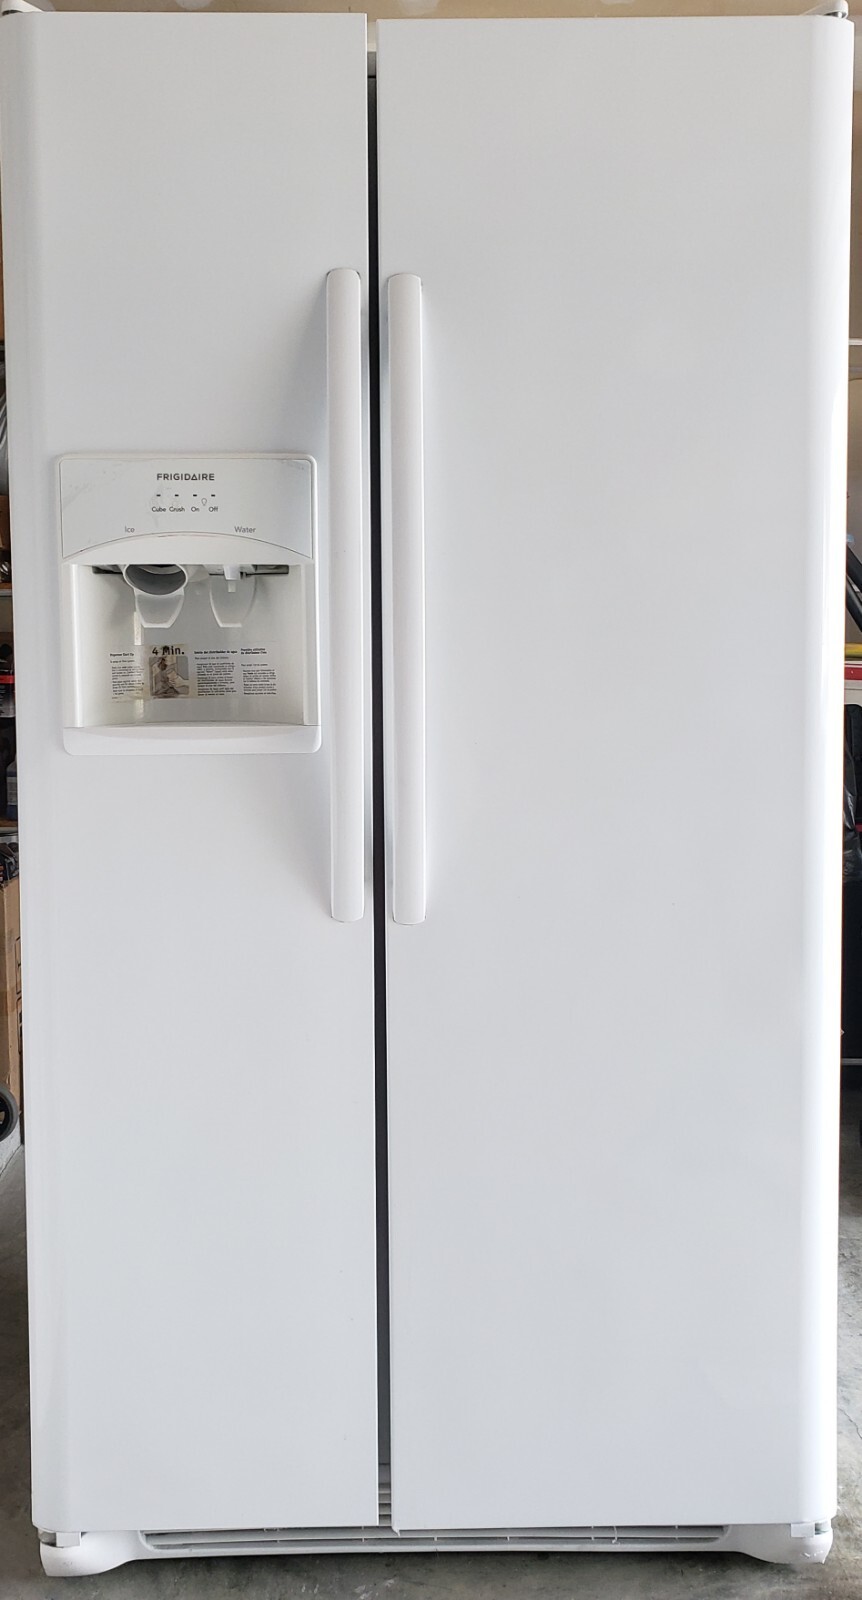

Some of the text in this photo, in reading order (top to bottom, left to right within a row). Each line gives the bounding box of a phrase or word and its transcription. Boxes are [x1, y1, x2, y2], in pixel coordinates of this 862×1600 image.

[157, 473, 215, 481] FRIGIDAIRE
[124, 525, 136, 533] Ice
[234, 525, 257, 533] Water
[151, 647, 159, 655] 4
[162, 645, 185, 656] Min.
